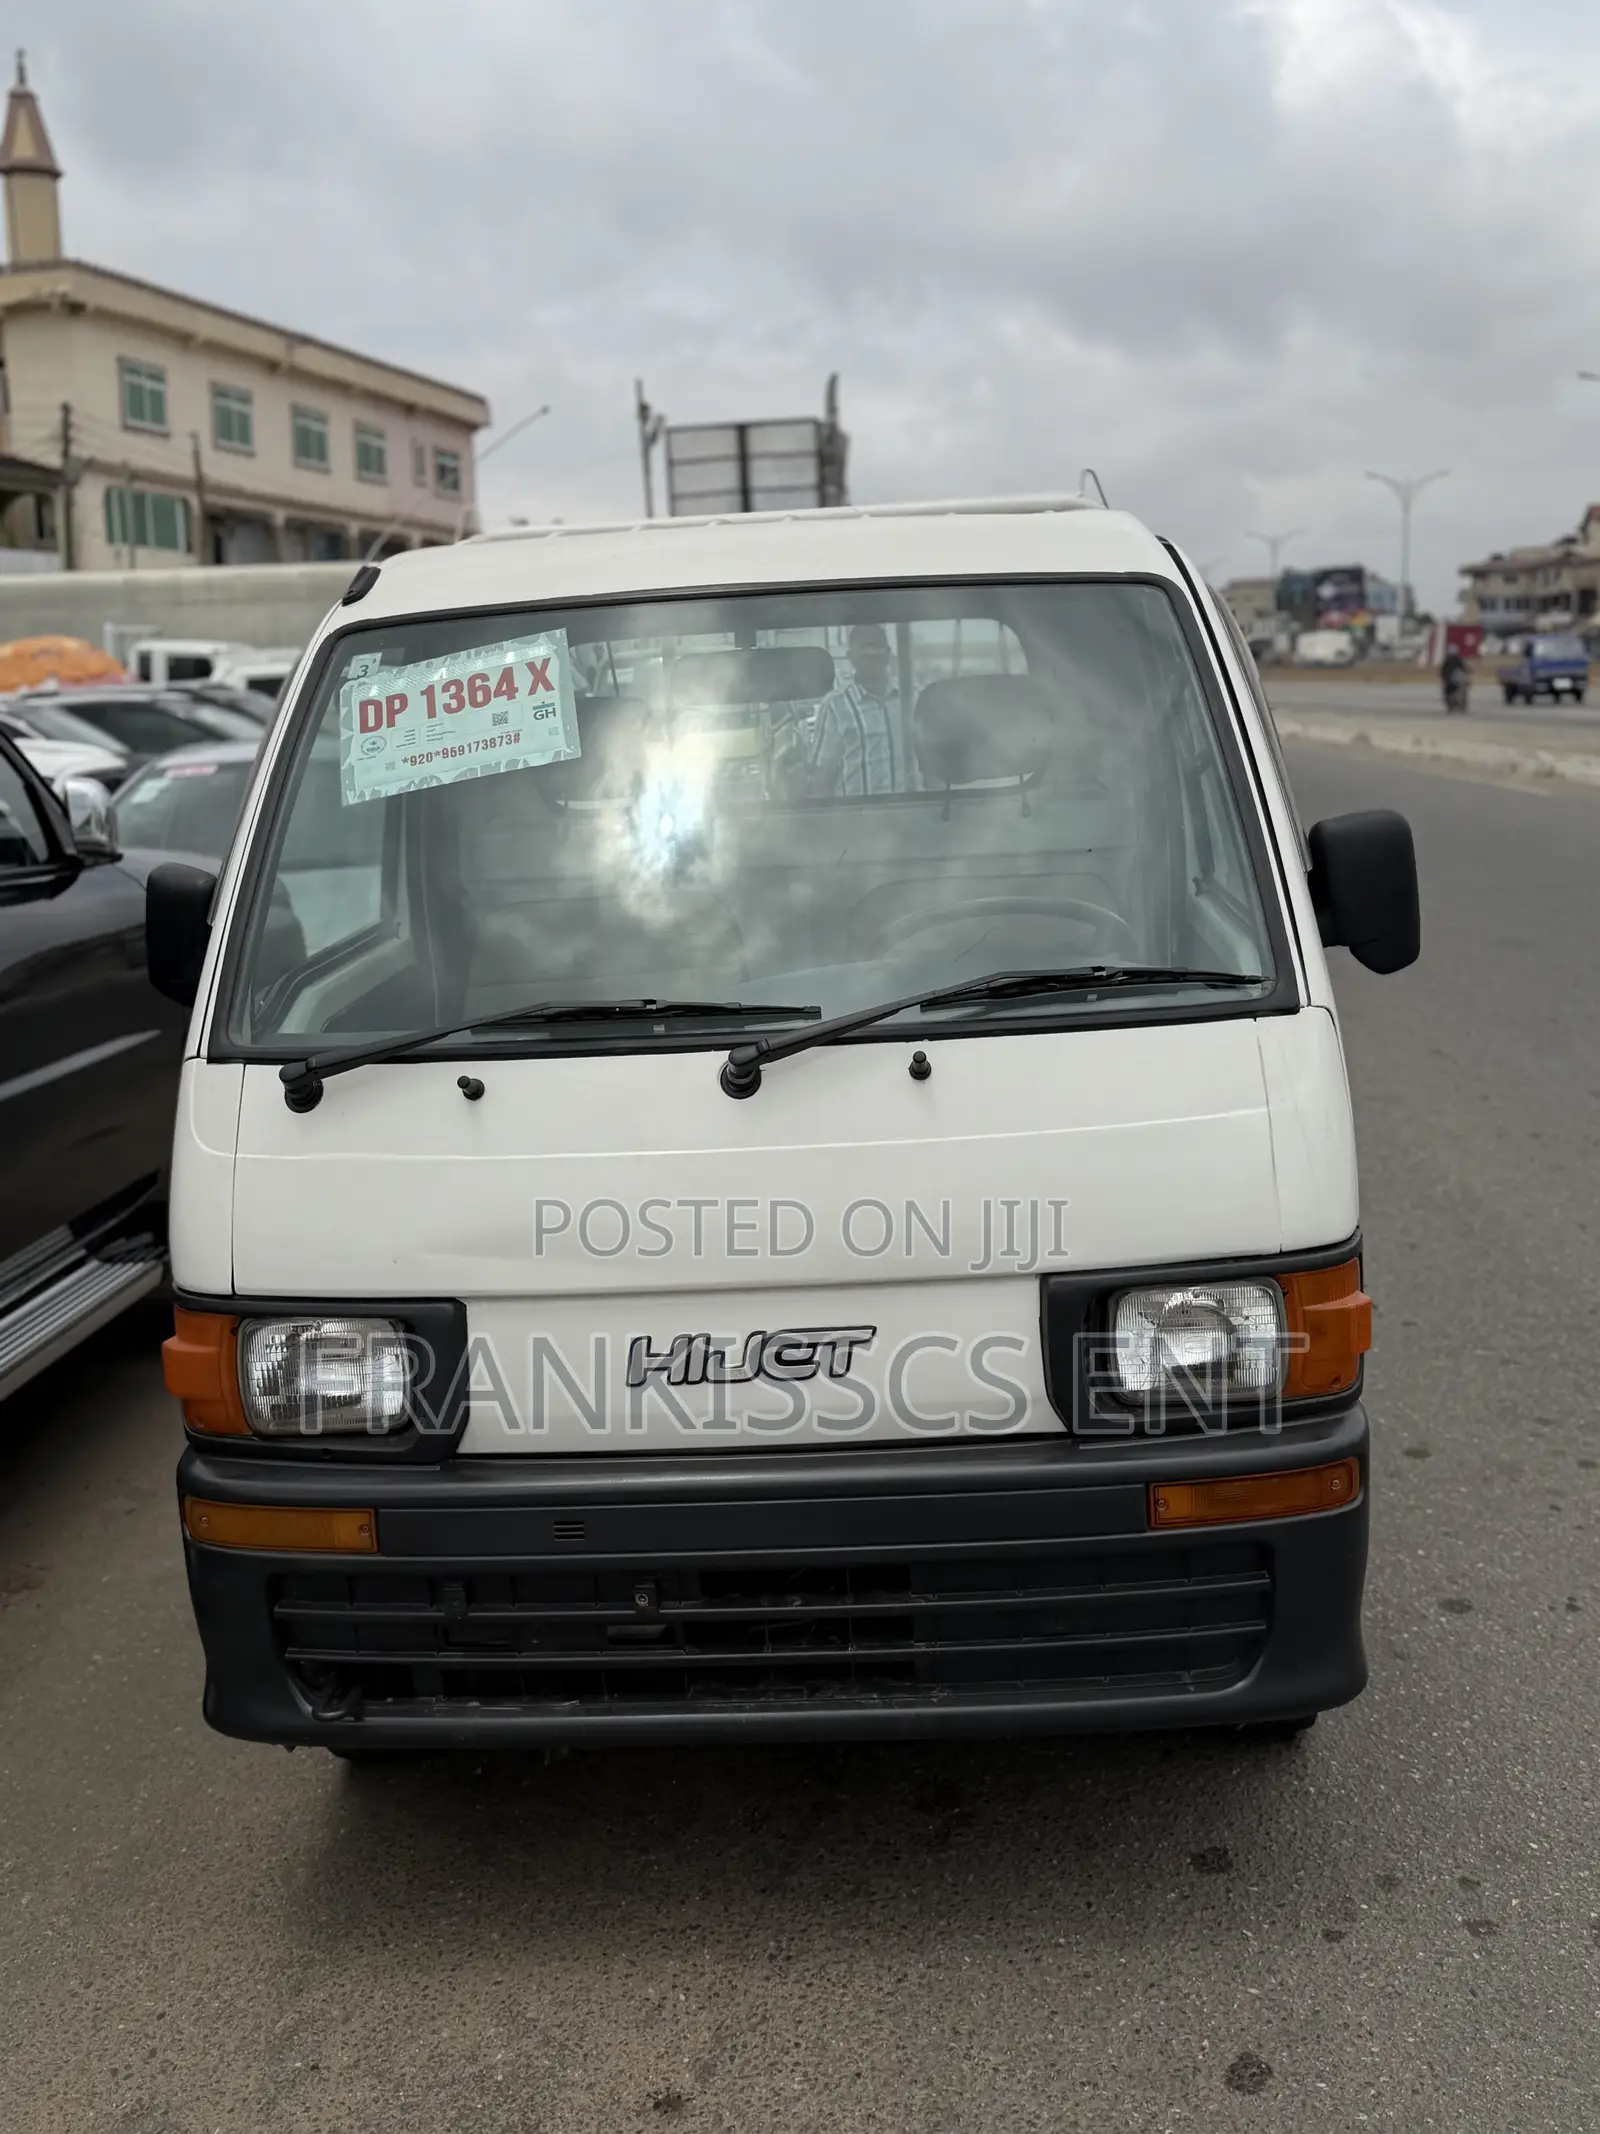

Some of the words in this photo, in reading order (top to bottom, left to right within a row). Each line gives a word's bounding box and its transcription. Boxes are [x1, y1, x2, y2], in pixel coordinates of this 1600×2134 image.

[359, 692, 408, 734] DP
[420, 666, 519, 720] 1364
[525, 657, 556, 696] X
[533, 707, 557, 721] GH
